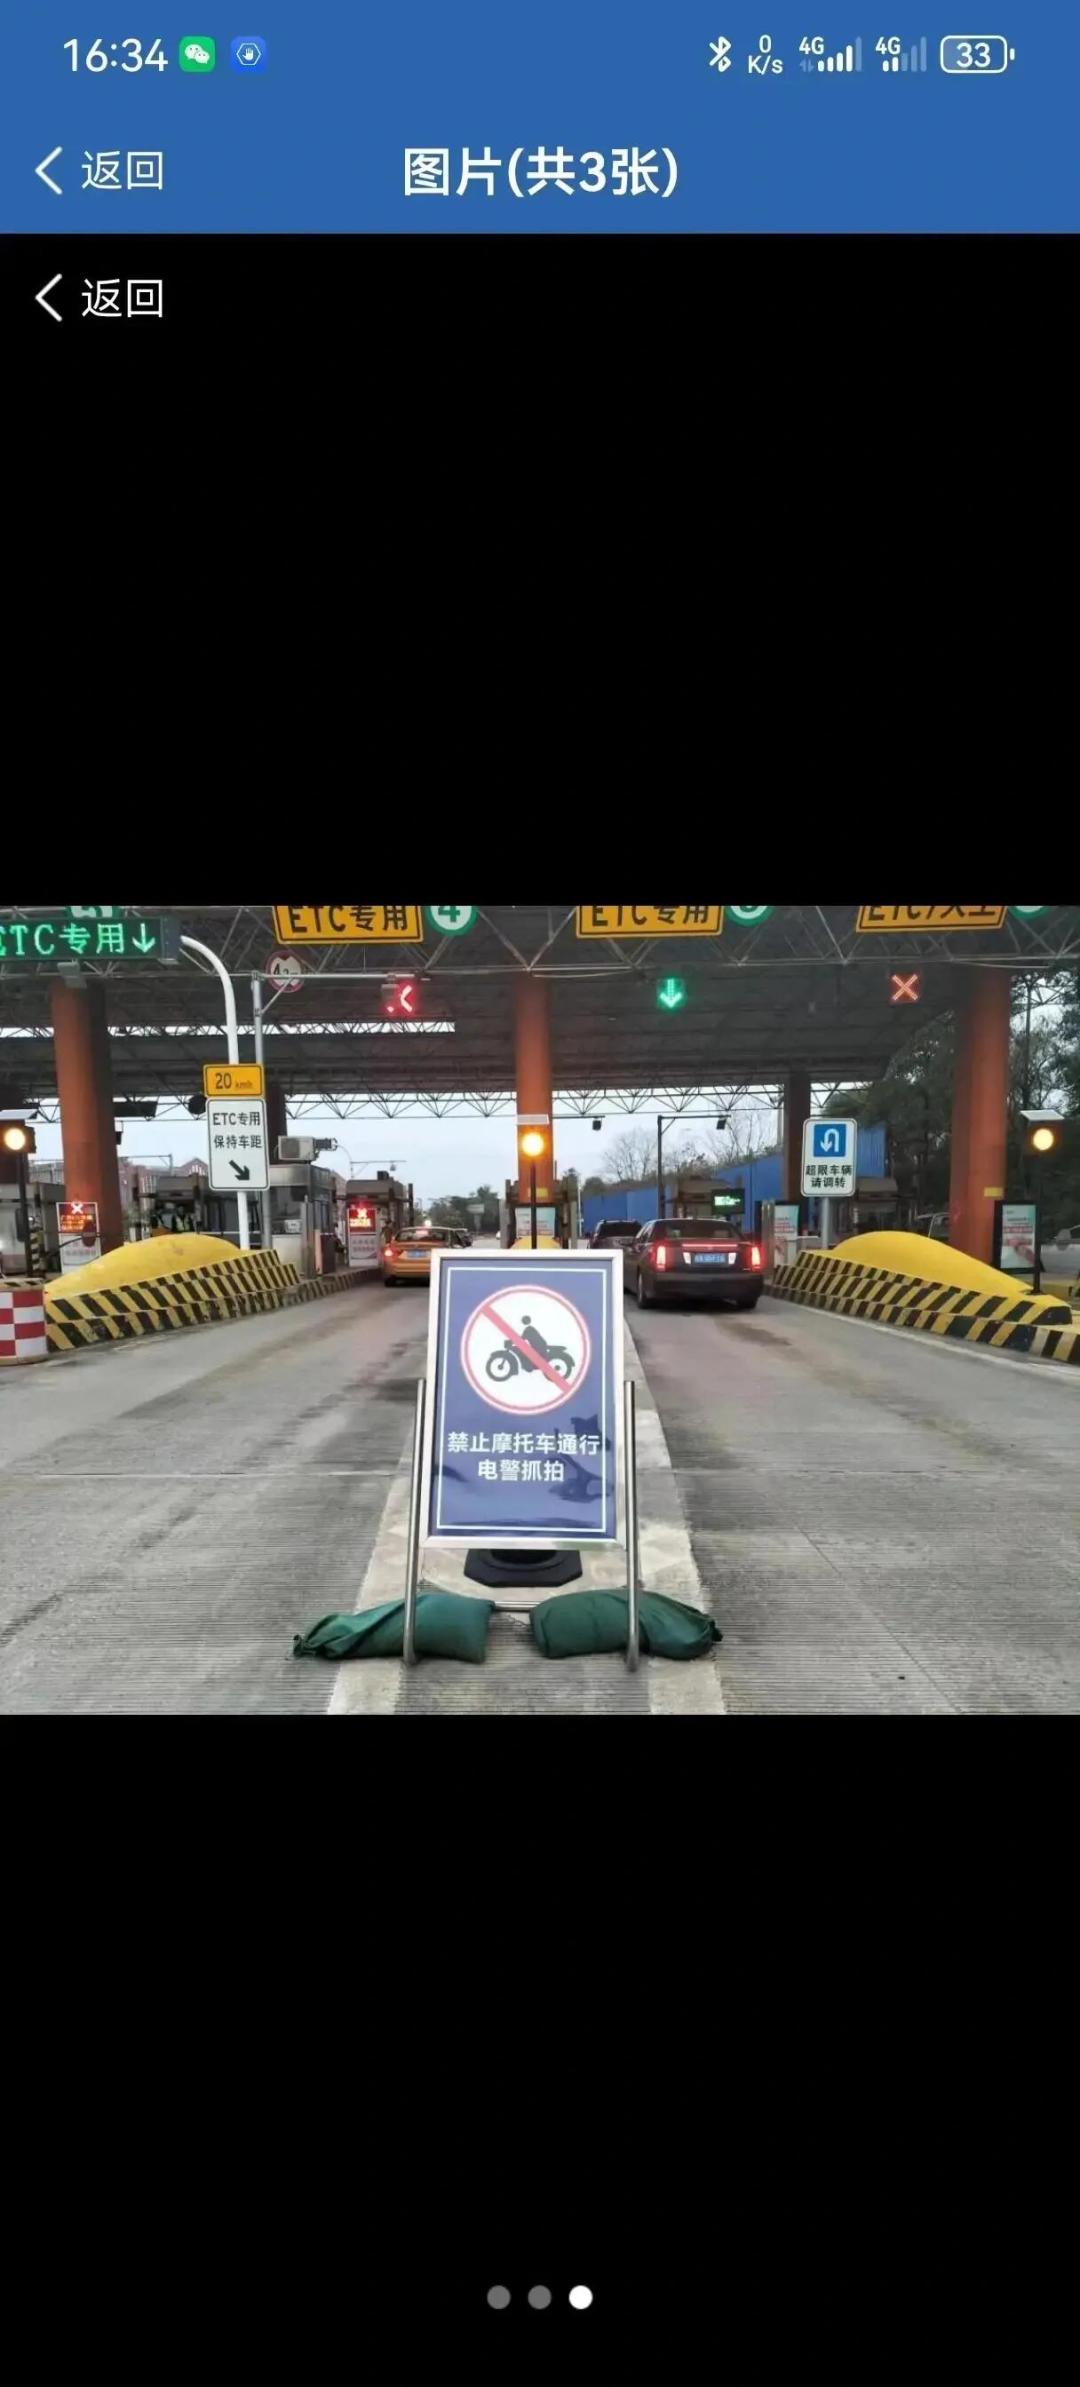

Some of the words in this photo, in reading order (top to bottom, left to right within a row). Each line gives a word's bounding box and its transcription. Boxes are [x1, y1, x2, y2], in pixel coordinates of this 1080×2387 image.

[215, 1072, 232, 1090] 20
[212, 1111, 261, 1126] ETC专用
[213, 1134, 263, 1149] 保持车距
[805, 1164, 852, 1176] 超限车辆
[447, 1432, 600, 1456] 禁止摩托车通行
[477, 1458, 565, 1482] 电警抓拍
